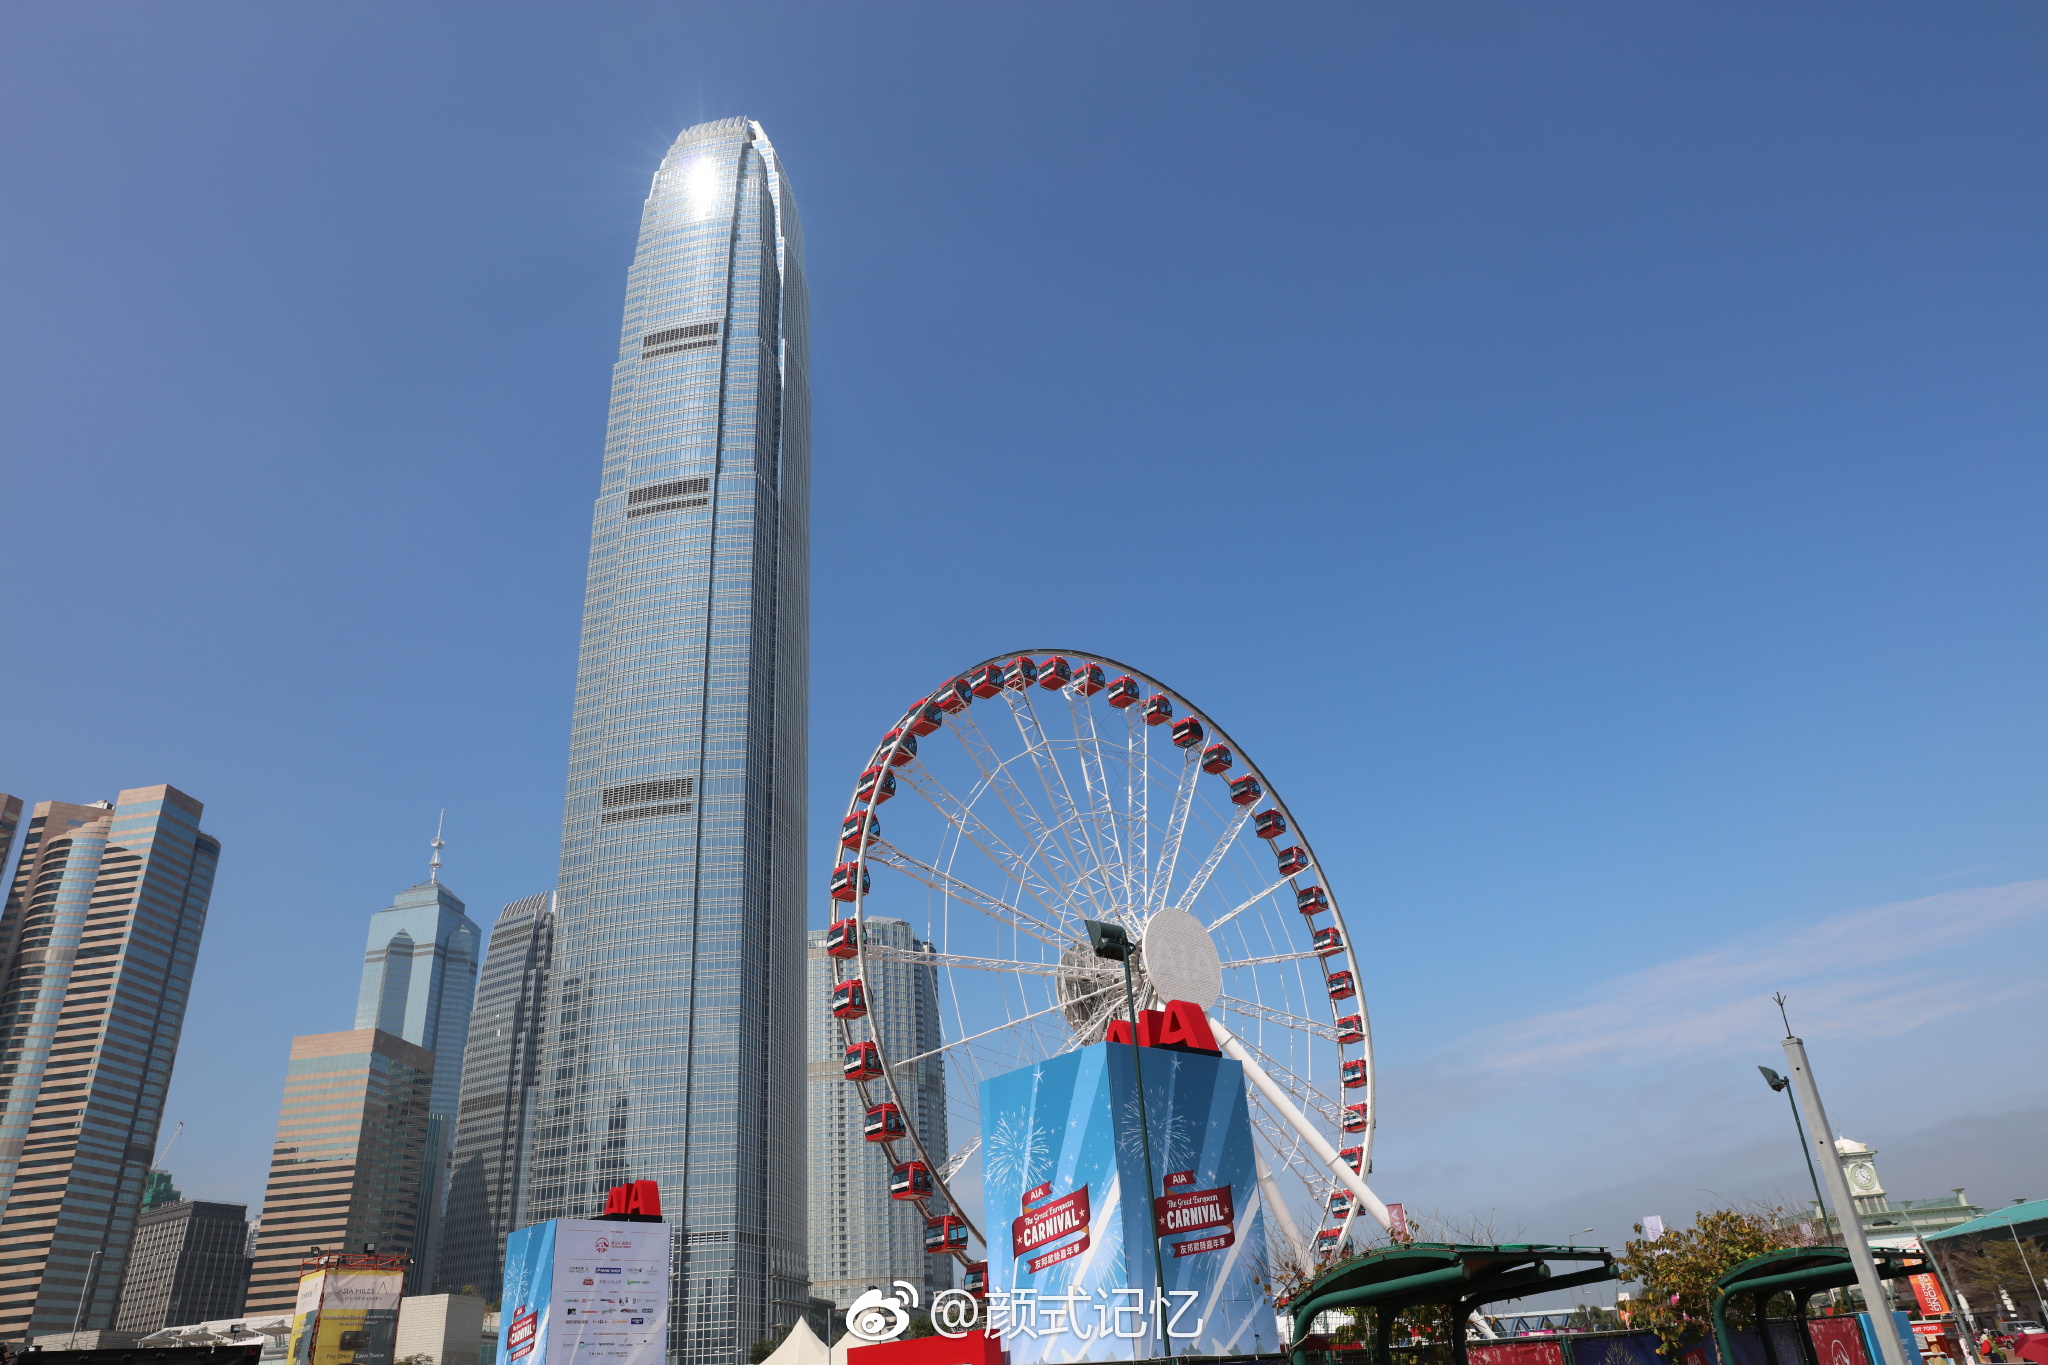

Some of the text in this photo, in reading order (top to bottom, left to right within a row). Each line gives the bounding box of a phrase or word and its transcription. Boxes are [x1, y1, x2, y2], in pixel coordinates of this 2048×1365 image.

[1106, 1000, 1220, 1052] AIA
[1172, 1174, 1187, 1184] AIA
[604, 1180, 661, 1216] AIA
[1030, 1188, 1044, 1200] AIA
[1167, 1194, 1218, 1208] The Great European
[1024, 1200, 1074, 1226] The Great European
[1166, 1203, 1224, 1229] CARNIVAL
[1024, 1208, 1079, 1247] CARNIVAL
